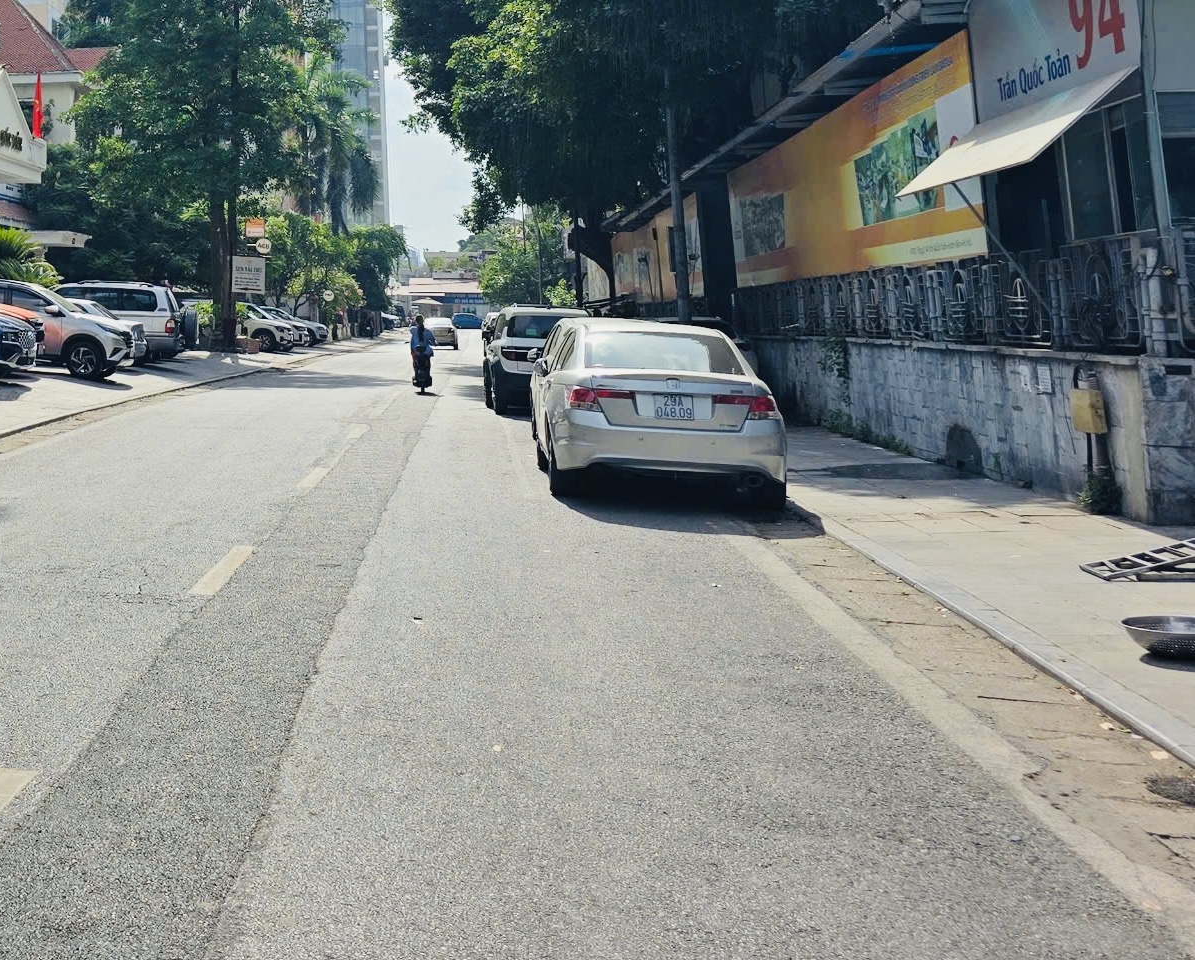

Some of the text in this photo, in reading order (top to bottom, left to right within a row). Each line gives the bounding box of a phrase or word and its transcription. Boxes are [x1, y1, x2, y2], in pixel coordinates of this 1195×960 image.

[997, 48, 1071, 102] Trần Quốc Toản
[664, 395, 684, 407] 29A
[656, 407, 692, 419] 048.09
